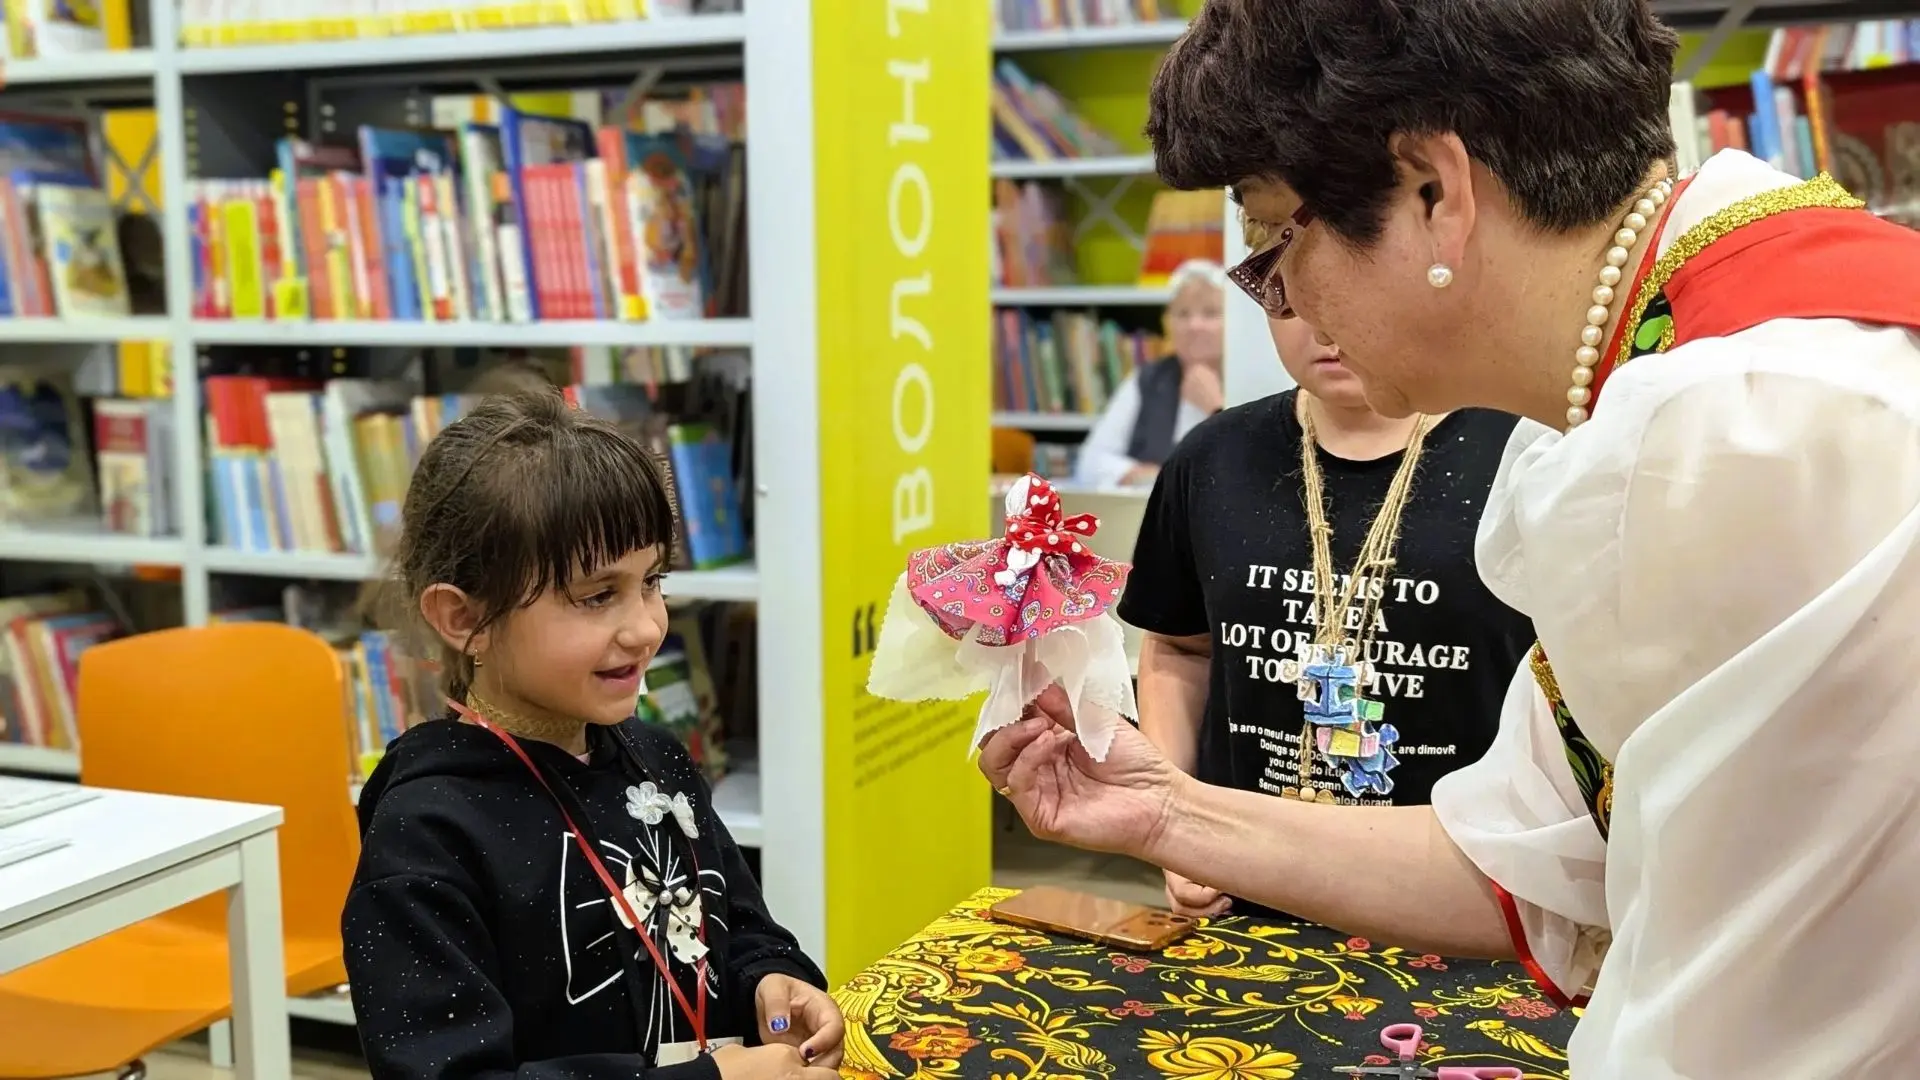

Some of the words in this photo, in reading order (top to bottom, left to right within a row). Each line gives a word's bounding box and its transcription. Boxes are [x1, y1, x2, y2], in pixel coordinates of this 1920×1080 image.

[1246, 565, 1278, 589] IT
[1393, 578, 1440, 605] TO
[1283, 599, 1363, 631] TAE
[1368, 608, 1390, 633] A
[1221, 622, 1266, 649] LOT
[1271, 629, 1310, 654] OF
[1341, 638, 1471, 671] URAGE
[1246, 655, 1282, 683] TO
[1240, 724, 1256, 734] are
[1398, 745, 1416, 755] are
[1269, 757, 1285, 768] you
